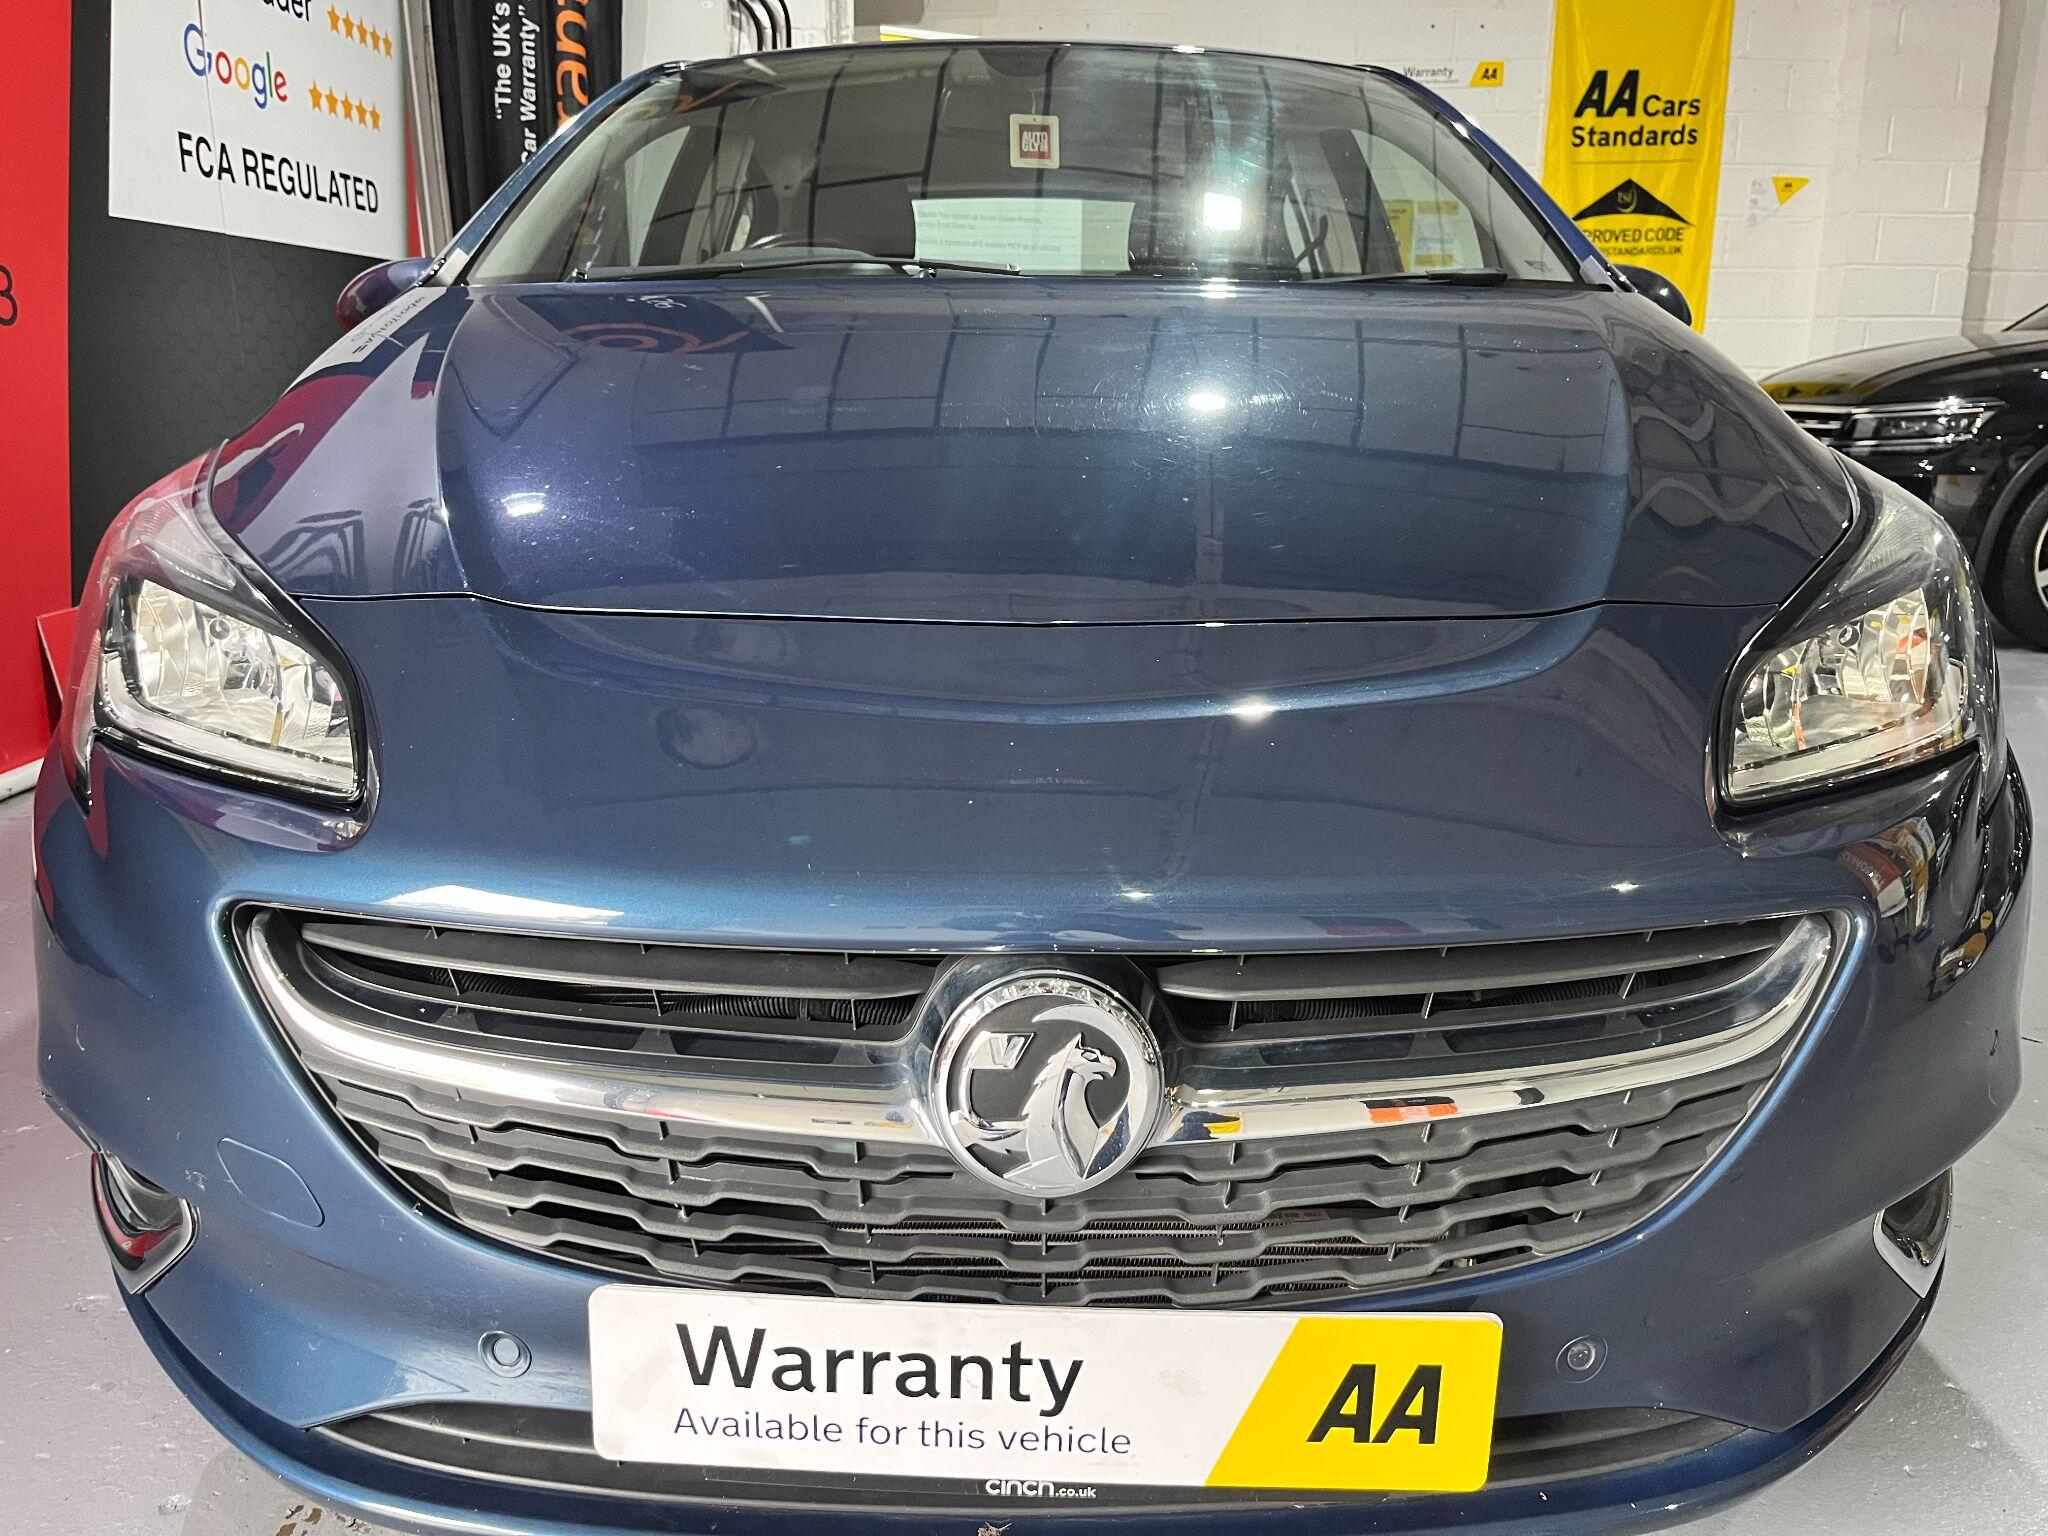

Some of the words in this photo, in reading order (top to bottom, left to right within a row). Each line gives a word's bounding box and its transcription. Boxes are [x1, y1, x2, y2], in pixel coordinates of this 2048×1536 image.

[492, 2, 511, 57] UK's
[183, 23, 288, 109] Google
[1403, 65, 1454, 78] Warranty
[1481, 67, 1498, 80] AA
[1574, 69, 1640, 117] AA
[1643, 94, 1701, 117] Cars
[1022, 131, 1048, 143] AUTO
[1571, 124, 1698, 147] Standards
[177, 131, 236, 184] FCA
[241, 148, 379, 213] REGULATED
[1645, 226, 1685, 242] CODE
[675, 1323, 1084, 1417] Warranty
[1306, 1363, 1442, 1444] AA
[674, 1407, 843, 1443] Available
[856, 1417, 909, 1446] for
[918, 1420, 986, 1450] this
[998, 1425, 1131, 1455] vehicle
